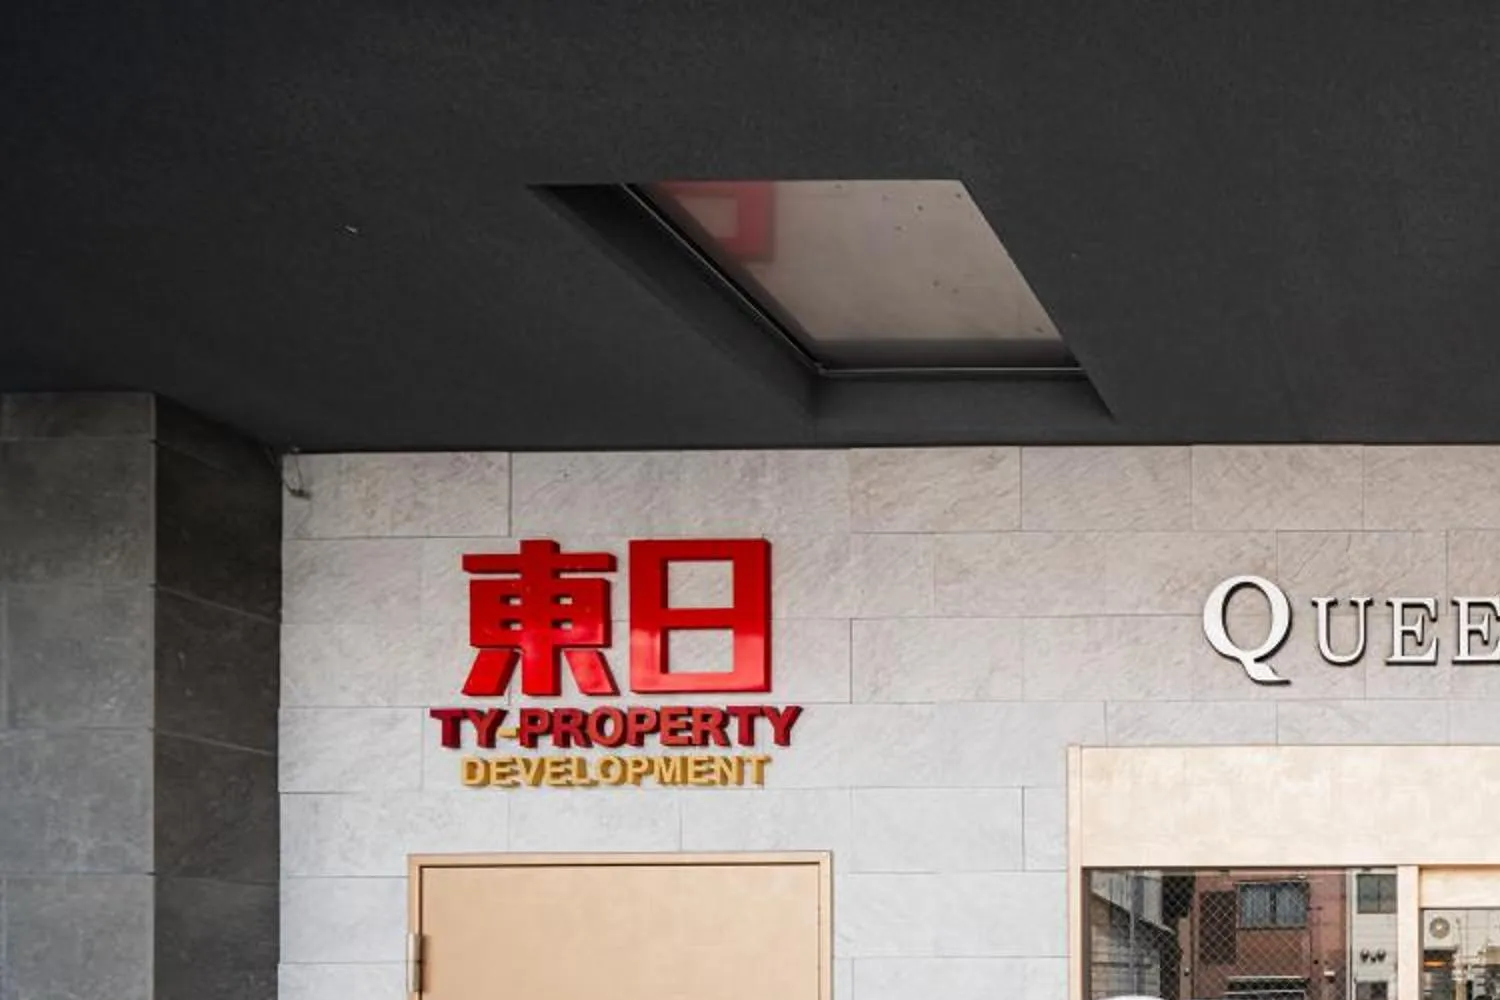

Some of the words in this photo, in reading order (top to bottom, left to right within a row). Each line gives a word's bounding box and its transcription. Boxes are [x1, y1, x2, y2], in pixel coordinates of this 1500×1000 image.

[461, 537, 773, 697] 東日
[429, 705, 803, 749] TY-PROPERTY
[460, 754, 774, 788] DEVELOPMENT
